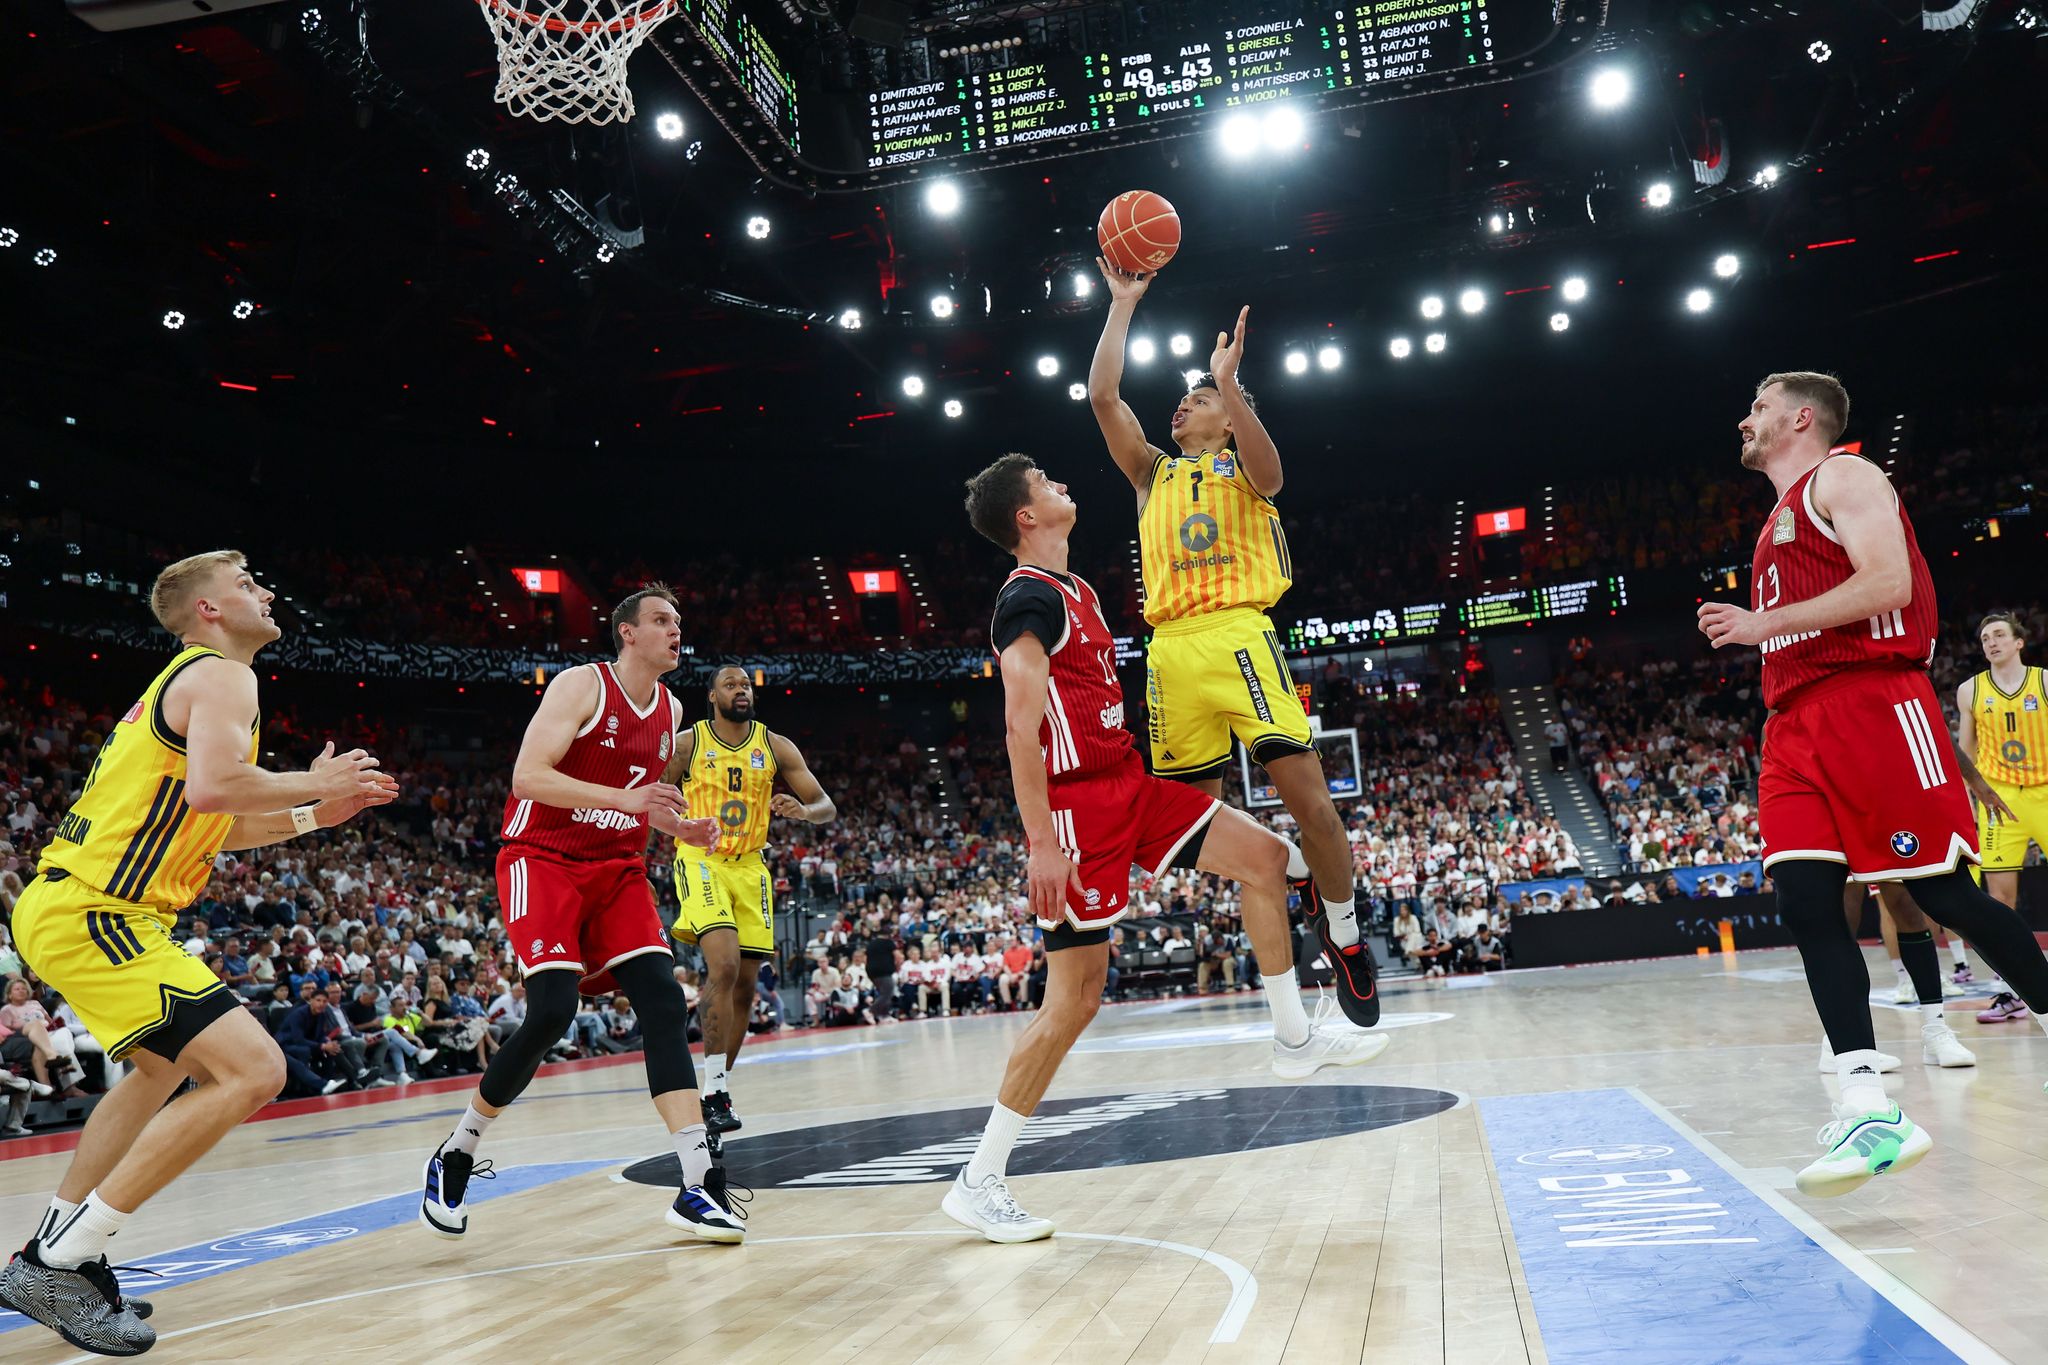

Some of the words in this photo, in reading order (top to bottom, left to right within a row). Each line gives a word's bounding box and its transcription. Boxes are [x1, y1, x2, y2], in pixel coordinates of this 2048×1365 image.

[1356, 6, 1370, 16] 13
[1358, 19, 1372, 29] 15
[1375, 3, 1458, 26] HERMANNSSON
[1226, 31, 1233, 40] 3
[1237, 21, 1292, 38] O'CONNELL
[1336, 11, 1343, 20] 0
[1227, 44, 1234, 53] 5
[1239, 36, 1282, 51] GRIESEL
[1284, 34, 1293, 42] S.
[1321, 28, 1328, 36] 1
[1337, 24, 1344, 33] 2
[1359, 32, 1373, 42] 17
[1377, 20, 1436, 39] AGBAKOKO
[1440, 18, 1450, 28] N.
[1463, 15, 1470, 23] 3
[1480, 12, 1487, 20] 6
[1180, 43, 1210, 56] ALBA
[1229, 57, 1236, 66] 6
[1241, 50, 1276, 64] DELOW
[1280, 47, 1291, 57] M.
[1323, 40, 1330, 48] 3
[1339, 37, 1346, 46] 0
[1361, 45, 1376, 55] 21
[1381, 38, 1415, 52] RATAJ
[1419, 36, 1430, 45] M.
[1464, 28, 1472, 37] 1
[1482, 25, 1488, 34] 7
[1363, 58, 1378, 68] 33
[1383, 51, 1418, 65] HUNDT
[1422, 49, 1432, 58] B.
[1484, 38, 1491, 47] 0
[989, 72, 1002, 82] 11
[1007, 66, 1034, 79] LUCIC
[1036, 65, 1045, 73] V.
[1085, 56, 1092, 64] 2
[1121, 54, 1152, 66] FCBB
[1124, 68, 1154, 88] 49
[1163, 65, 1174, 74] 3.
[1182, 58, 1212, 78] 43
[1231, 70, 1237, 78] 7
[1243, 64, 1272, 77] KAYIL
[1275, 62, 1284, 71] J.
[1341, 50, 1348, 59] 8
[1365, 72, 1380, 81] 34
[1385, 65, 1413, 78] BEAN
[1416, 64, 1426, 73] J.
[1468, 55, 1476, 63] 1
[1486, 51, 1493, 60] 3
[870, 94, 877, 102] 0
[881, 82, 944, 101] DIMITRIJEVIC
[973, 76, 980, 84] 5
[990, 85, 1004, 94] 13
[1008, 79, 1033, 91] OBST
[1102, 66, 1110, 74] 9
[1146, 78, 1193, 98] 05:58
[1224, 96, 1241, 106] 11
[1245, 90, 1276, 103] WOOD
[1280, 88, 1291, 96] M.
[1328, 80, 1335, 88] 1
[1344, 76, 1352, 85] 3
[1232, 83, 1239, 92] 9
[1243, 70, 1310, 90] MATTISSECK
[1313, 68, 1322, 77] J.
[1326, 67, 1333, 75] 1
[1343, 63, 1350, 72] 3
[871, 107, 878, 115] 1
[927, 97, 936, 105] O.
[991, 97, 1005, 107] 20
[1009, 90, 1046, 104] HARRIS
[1049, 88, 1058, 97] E.
[1104, 79, 1111, 87] 0
[993, 110, 1006, 120] 21
[1011, 102, 1054, 117] HOLLATZ
[1057, 100, 1066, 109] J.
[1089, 95, 1096, 103] 1
[1098, 92, 1112, 102] 10
[1139, 105, 1149, 116] 4
[1154, 99, 1190, 112] FOULS
[1194, 95, 1204, 107] 1
[873, 132, 880, 140] 5
[884, 125, 919, 138] GIFFEY
[922, 123, 931, 132] N.
[961, 117, 968, 125] 1
[976, 114, 983, 123] 2
[882, 106, 960, 126] RATHAN-MAYES
[975, 101, 982, 110] 0
[994, 123, 1007, 133] 22
[1012, 118, 1037, 130] MIKE
[1040, 117, 1045, 125] I.
[1091, 108, 1098, 116] 3
[1107, 105, 1114, 113] 2
[874, 144, 880, 153] 7
[884, 134, 942, 152] VOIGTMANN
[962, 130, 969, 138] 1
[978, 127, 985, 135] 9
[995, 136, 1009, 145] 33
[1013, 124, 1077, 142] MCCORMACK
[1080, 123, 1090, 131] D.
[1092, 121, 1099, 129] 2
[1108, 118, 1115, 126] 2
[869, 157, 882, 167] 10
[886, 150, 925, 164] JESSUP
[928, 148, 936, 157] J.
[964, 143, 970, 151] 1
[979, 140, 986, 148] 2
[1191, 471, 1203, 501] 7
[1172, 554, 1236, 572] Schindler
[1755, 562, 1780, 613] 13
[1304, 623, 1328, 638] 49
[1331, 619, 1370, 634] 05:58
[1373, 615, 1397, 630] 43
[1238, 651, 1270, 723] BIKELEASING.DE
[2005, 712, 2016, 732] 11
[625, 765, 647, 790] 7
[727, 767, 742, 792] 13
[56, 811, 92, 846] ERLIN
[1538, 1168, 1759, 1248] BMW
